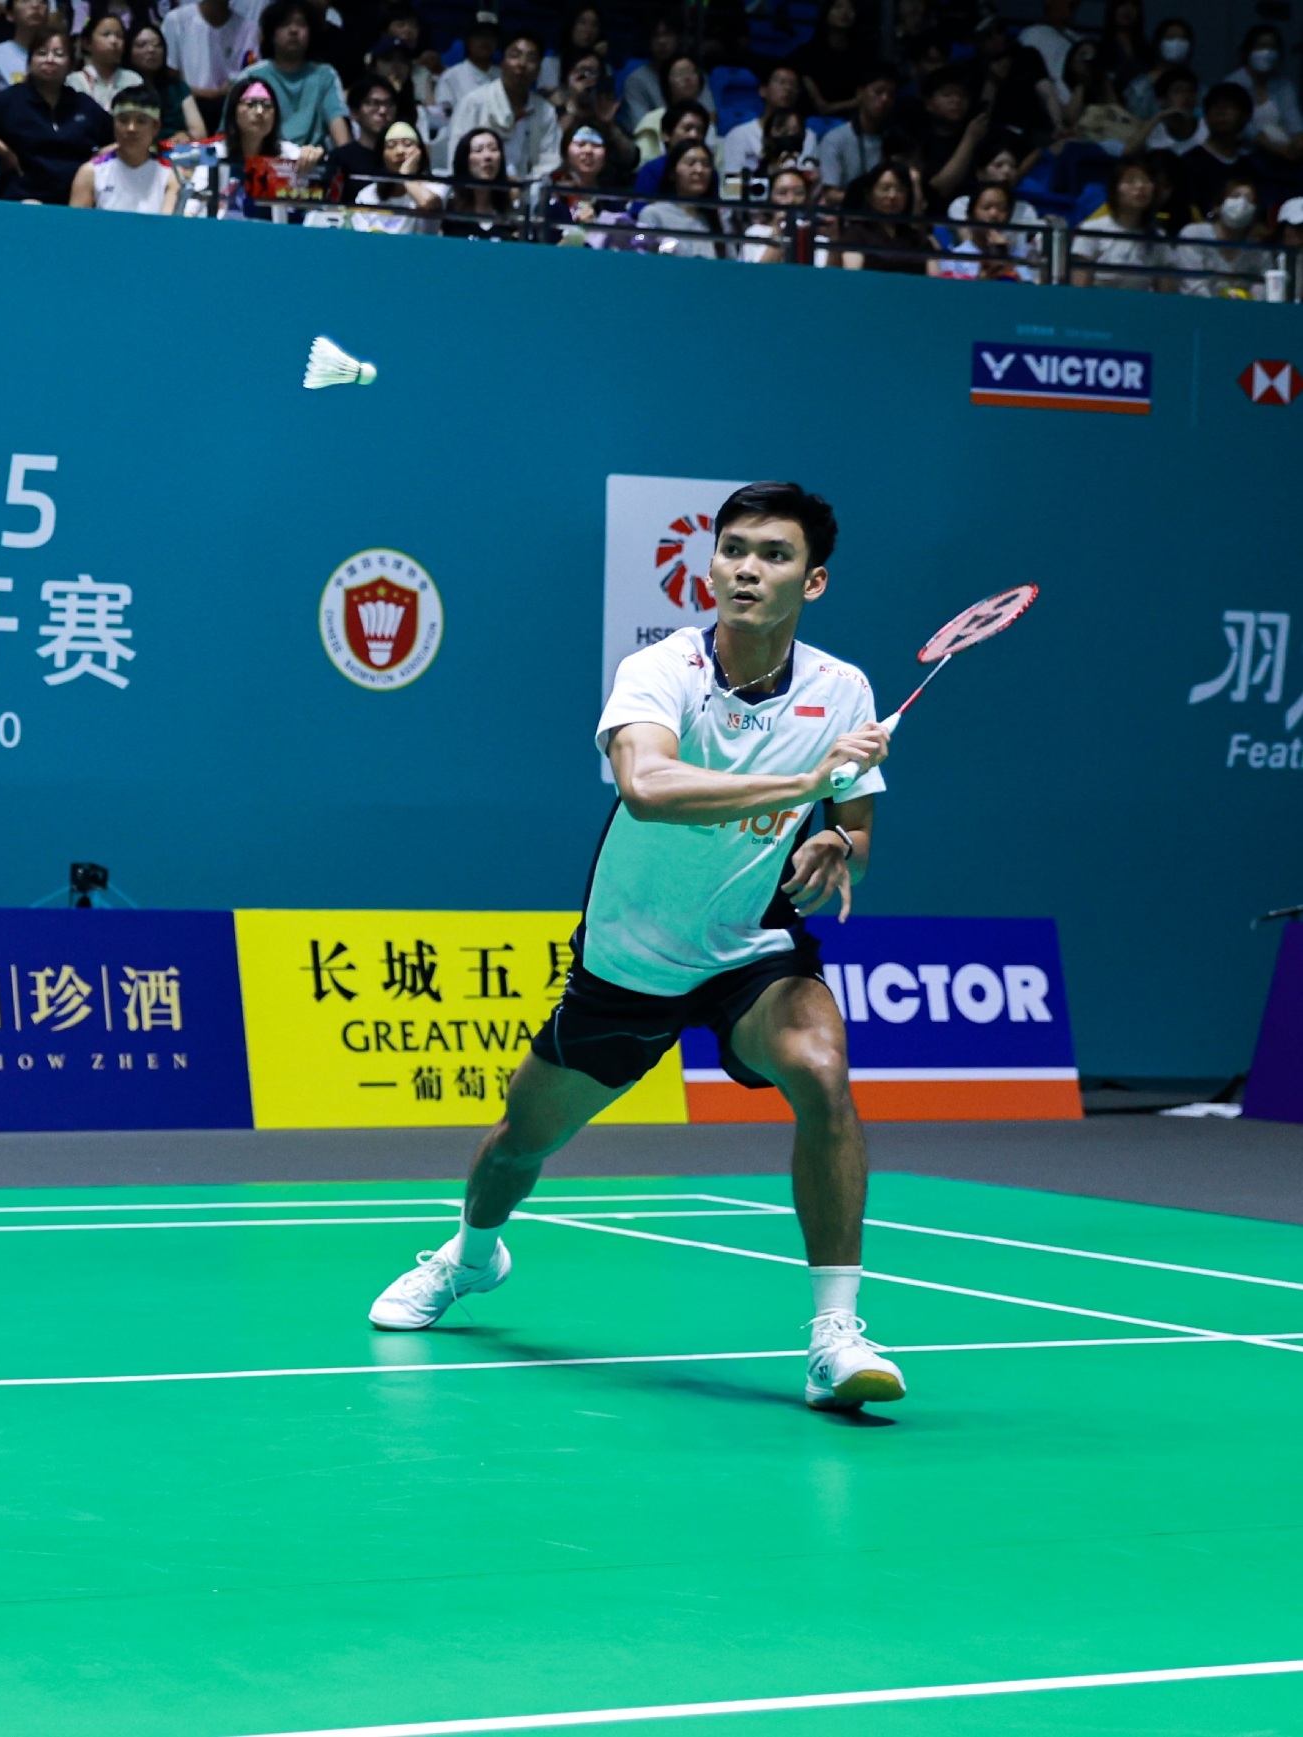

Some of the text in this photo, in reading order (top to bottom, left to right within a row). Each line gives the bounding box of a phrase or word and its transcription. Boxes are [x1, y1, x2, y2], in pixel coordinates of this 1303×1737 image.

[1023, 353, 1145, 390] VICTOR
[1188, 610, 1303, 732] 羽
[1226, 733, 1303, 769] Feat
[341, 1019, 547, 1052] GREATWA
[91, 1053, 190, 1071] ZHEN
